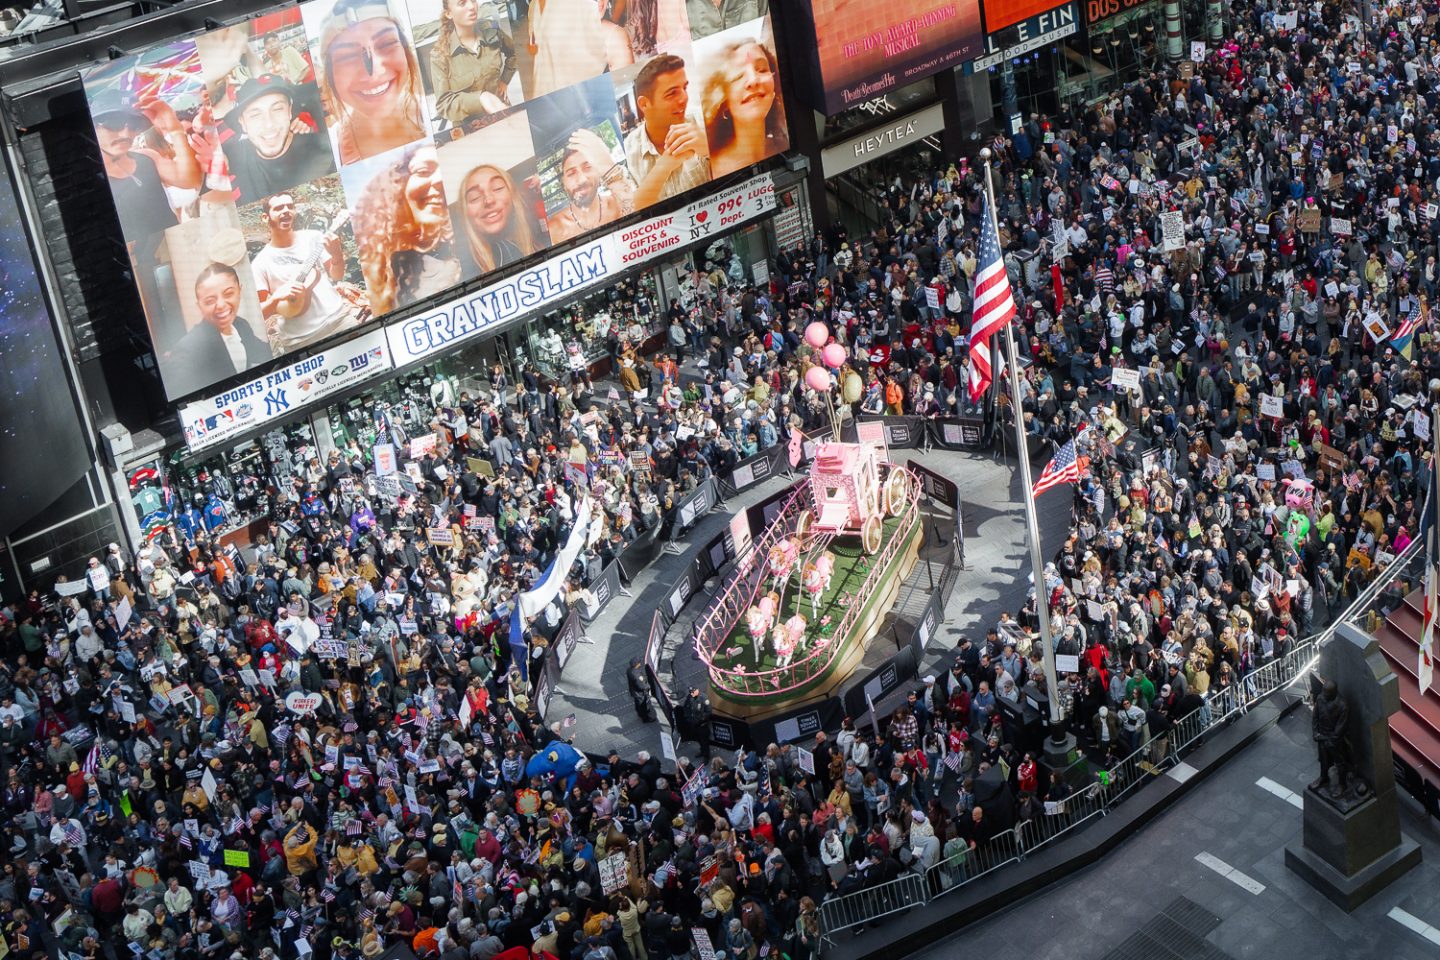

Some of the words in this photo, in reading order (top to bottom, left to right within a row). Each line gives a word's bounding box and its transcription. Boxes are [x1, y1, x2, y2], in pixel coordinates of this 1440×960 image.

[1038, 4, 1073, 34] FIN
[884, 35, 921, 59] MUSICAL
[971, 43, 1028, 71] SEAFOOD
[1042, 24, 1076, 43] SUSHI
[904, 60, 938, 77] BROADWAY
[853, 123, 915, 157] HEYTEA
[719, 184, 749, 200] Souvenir
[749, 175, 768, 189] Shop
[718, 195, 743, 215] 99¢
[756, 198, 764, 211] 3
[622, 217, 674, 242] DISCOUNT
[690, 221, 711, 241] NY
[720, 212, 745, 226] Dept.
[622, 235, 681, 264] SOUVENIRS
[629, 233, 657, 251] GIFTS
[659, 230, 668, 239] &
[404, 284, 519, 355] GRAND
[517, 244, 608, 307] SLAM
[216, 380, 263, 409] SPORTS
[266, 367, 291, 389] FAN
[295, 354, 325, 376] SHOP
